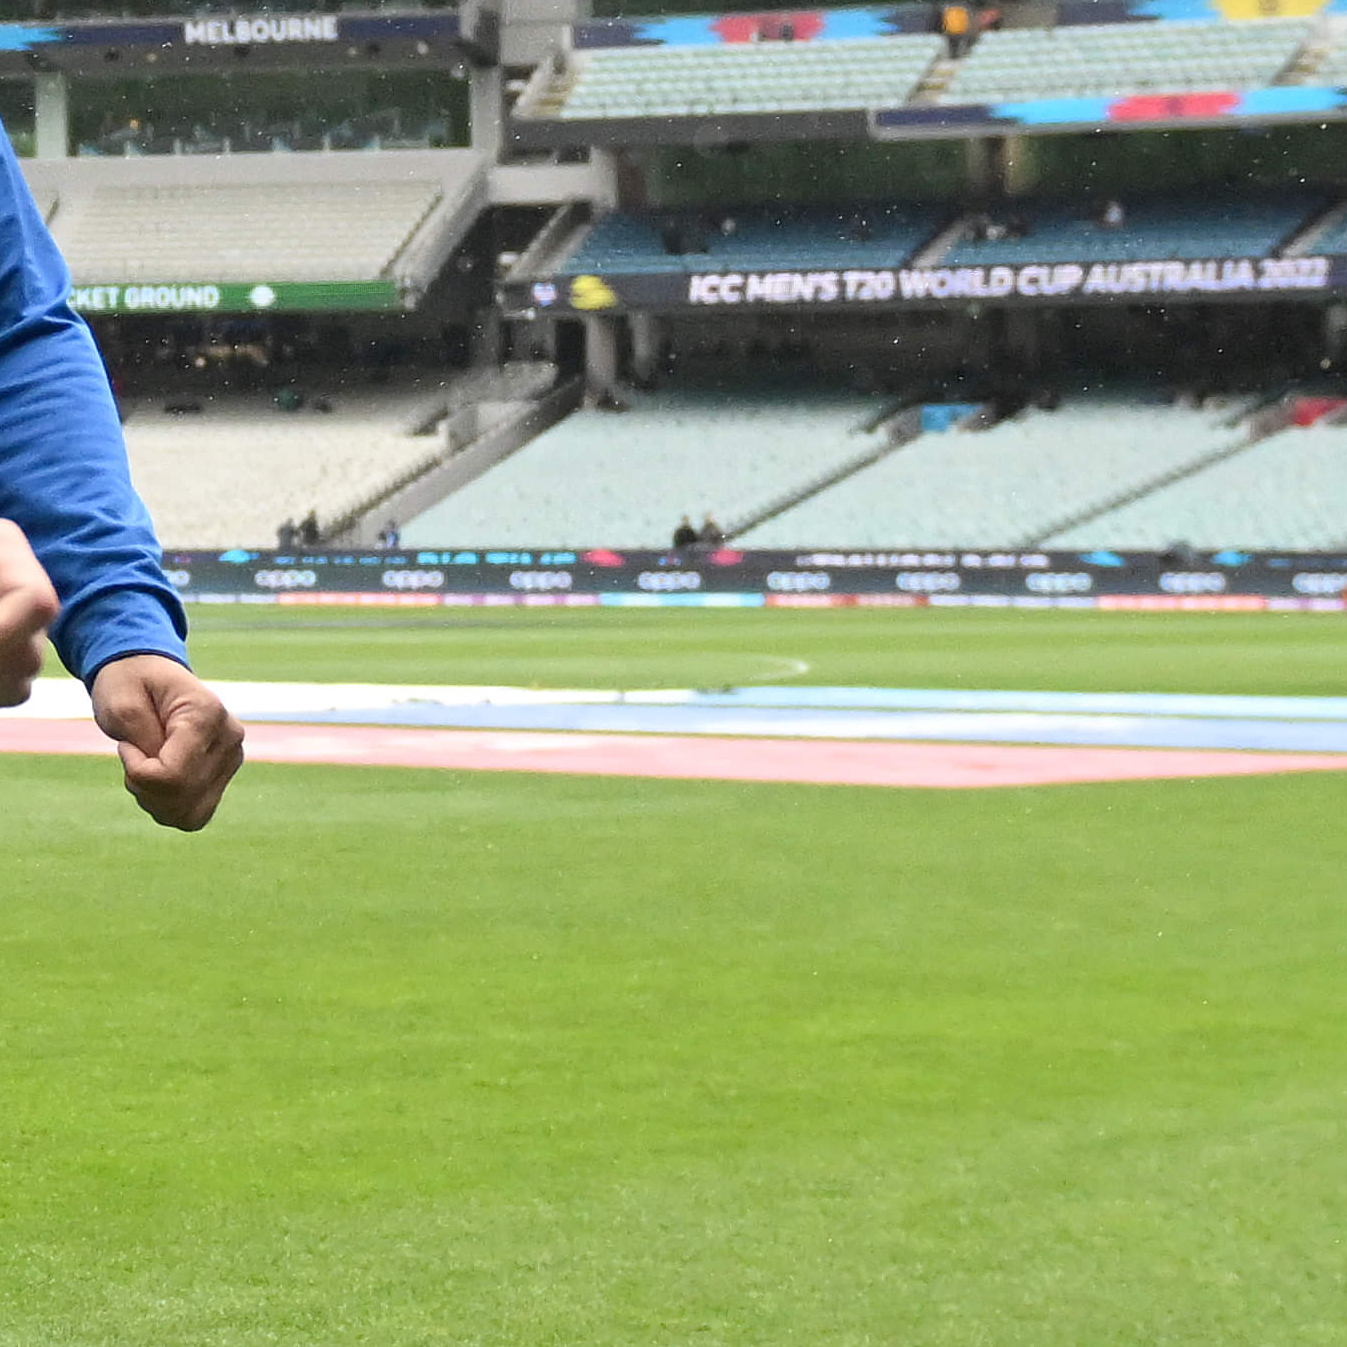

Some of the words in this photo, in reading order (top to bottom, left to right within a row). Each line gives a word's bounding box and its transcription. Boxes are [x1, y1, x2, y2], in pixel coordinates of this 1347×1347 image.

[184, 15, 340, 45] MELBOURNE
[690, 274, 745, 303] ICC
[746, 271, 840, 302] MEN'S
[842, 269, 896, 300] T20
[898, 266, 1014, 299] WORLD
[1016, 264, 1083, 296] CUP
[1082, 260, 1256, 293] AUSTRALIA
[124, 286, 220, 309] GROUND
[254, 569, 317, 589] oppo
[382, 570, 444, 589] oppo
[509, 570, 573, 590] oppo
[637, 571, 702, 590] oppo
[766, 571, 831, 591] oppo
[895, 571, 961, 592] oppo
[1025, 572, 1093, 592] oppo
